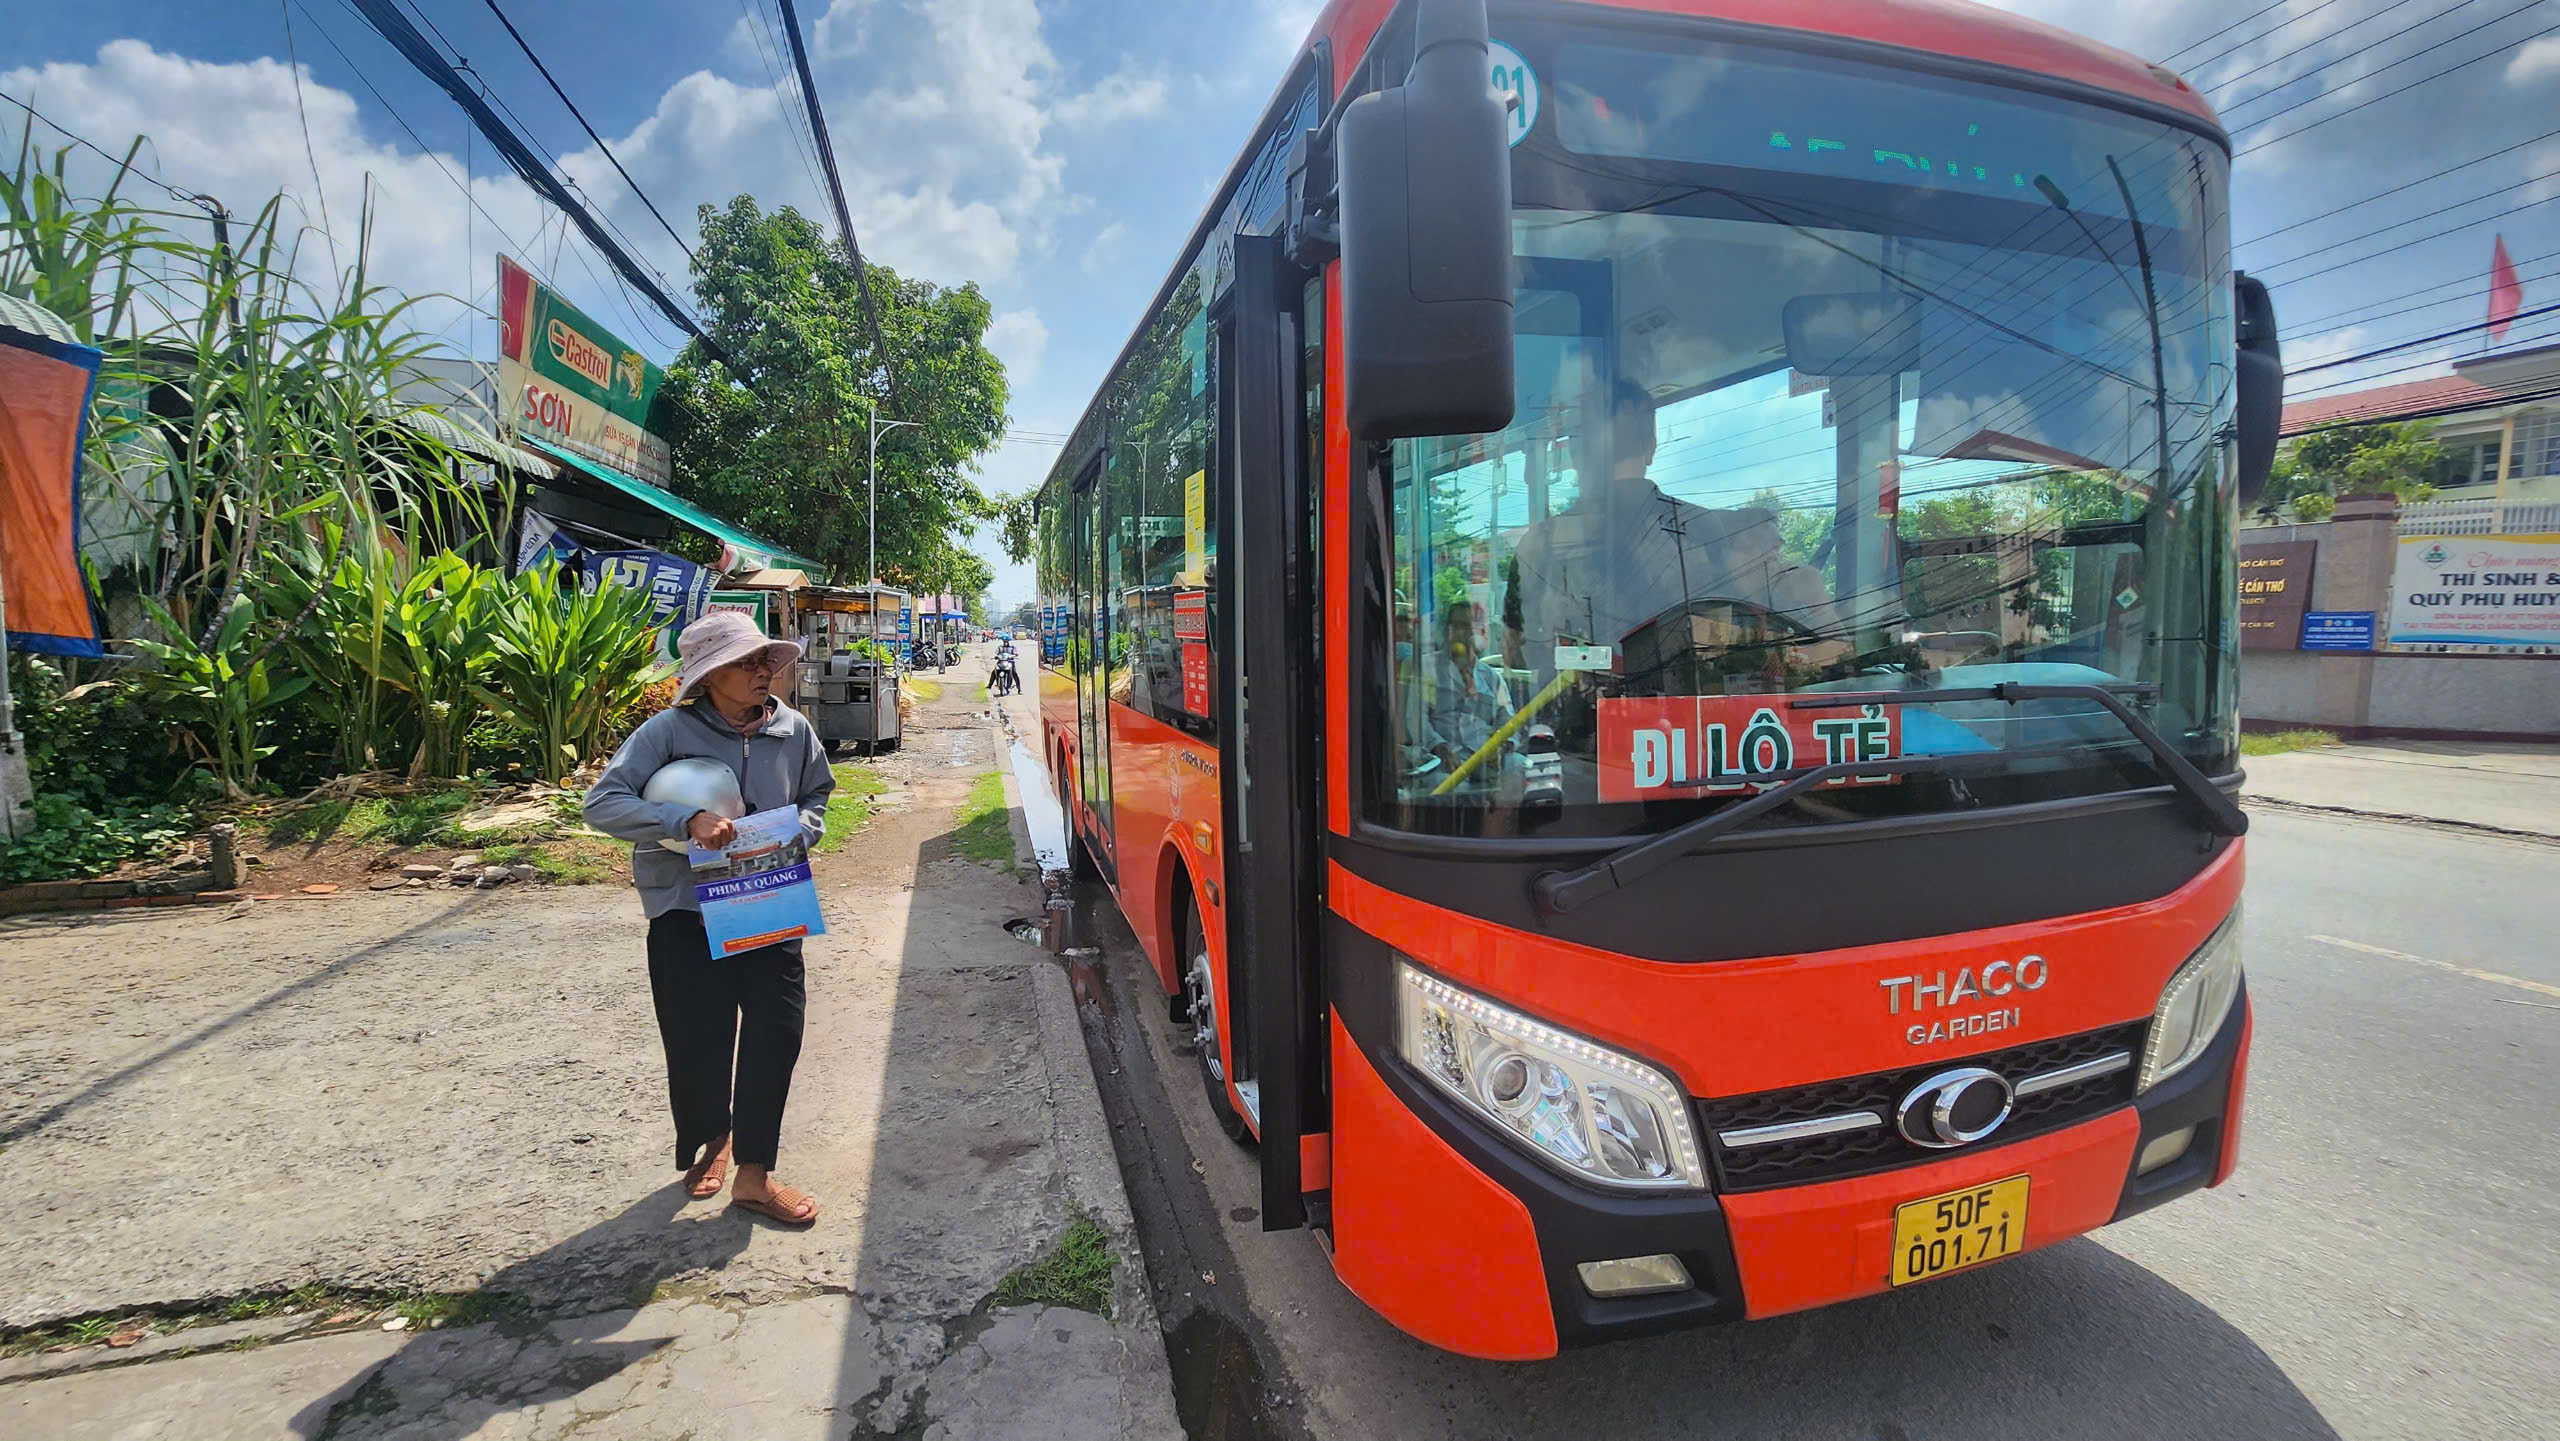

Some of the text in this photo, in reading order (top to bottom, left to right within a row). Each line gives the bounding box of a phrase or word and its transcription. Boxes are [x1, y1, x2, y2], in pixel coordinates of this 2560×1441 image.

[566, 334, 608, 384] Castrol
[525, 385, 573, 437] SƠN
[2409, 590, 2455, 608] QUÝ
[2461, 592, 2505, 609] PHỤ
[2439, 571, 2476, 586] THÍ
[2483, 572, 2537, 586] SINH
[1631, 728, 1688, 788] ĐI
[1813, 703, 1891, 785] TẺ
[707, 870, 798, 897] PHIM X QUANG
[1880, 954, 2049, 1015] THACO
[1906, 1008, 2021, 1046] GARDEN
[1936, 1190, 1993, 1233] 50F
[1908, 1221, 2009, 1278] 001.71
